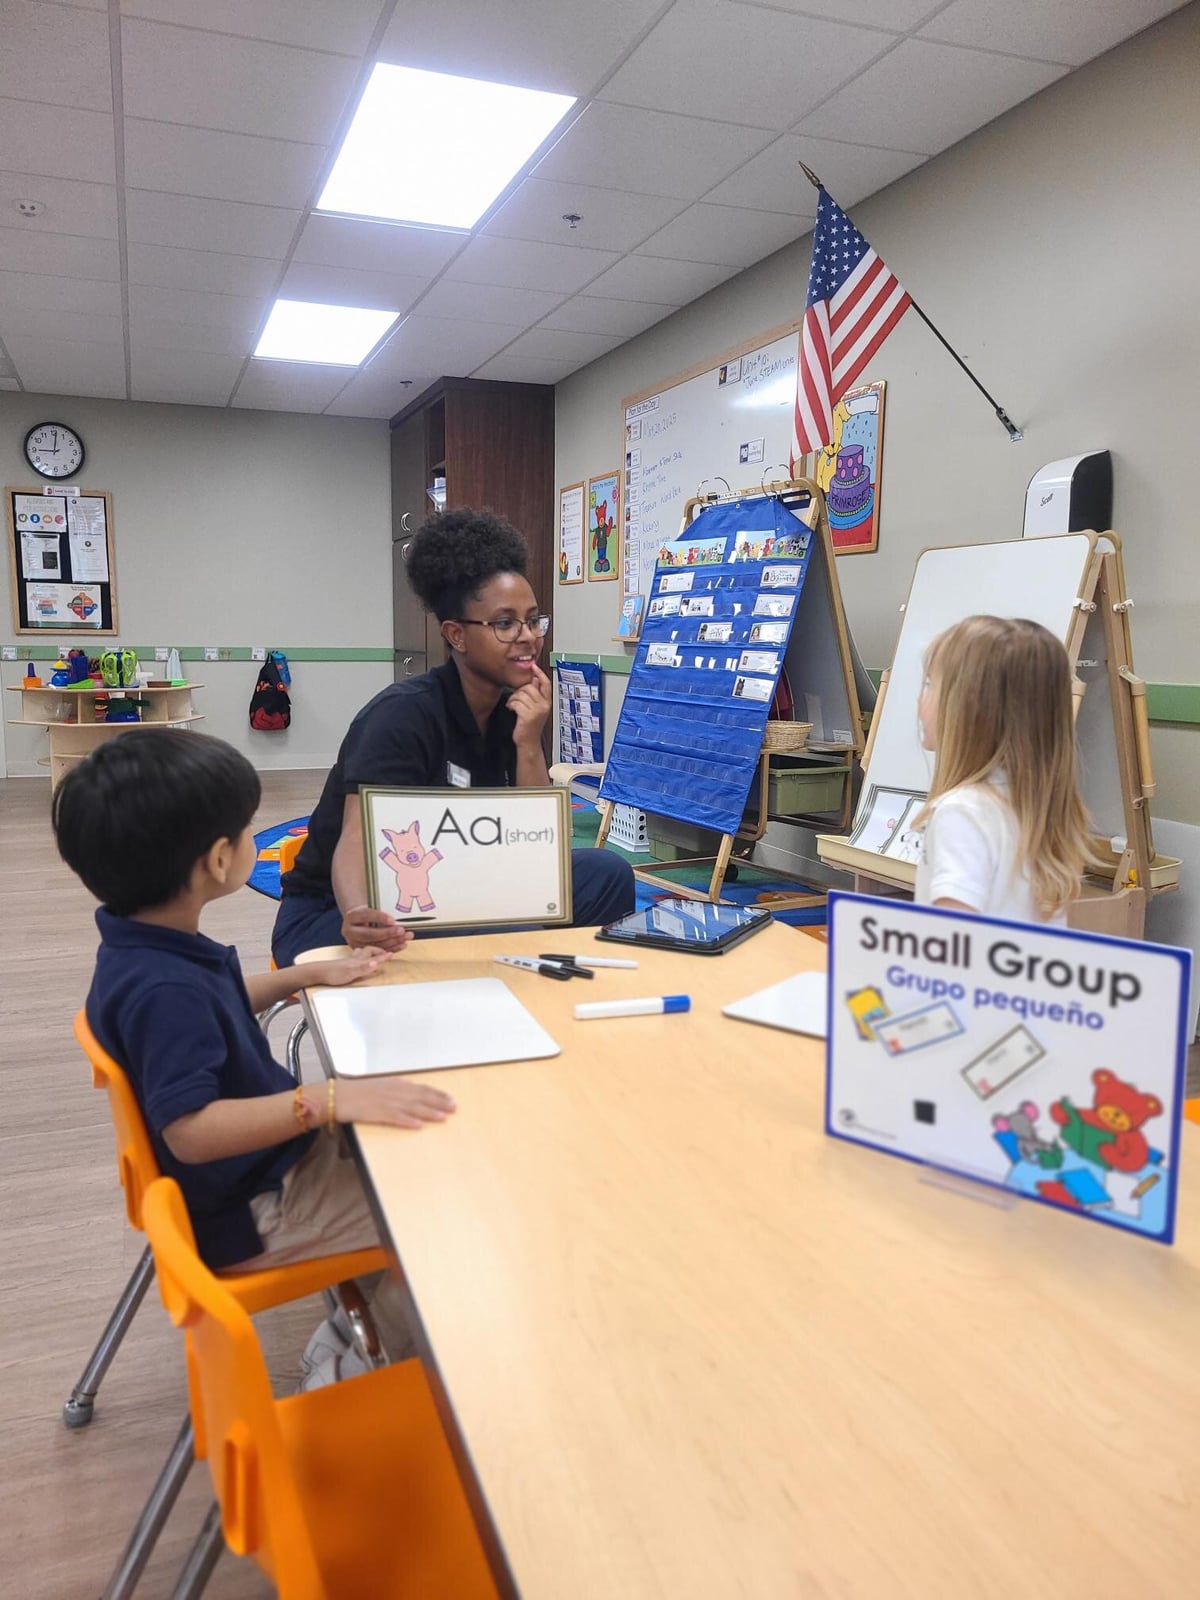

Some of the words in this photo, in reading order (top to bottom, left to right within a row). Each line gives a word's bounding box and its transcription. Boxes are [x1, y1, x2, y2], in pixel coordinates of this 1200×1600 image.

[430, 807, 503, 846] Aa
[504, 827, 555, 846] (short)
[860, 916, 972, 969] Small
[986, 940, 1142, 1008] Group
[885, 965, 966, 1000] Grupo
[973, 986, 1105, 1031] pequeño
